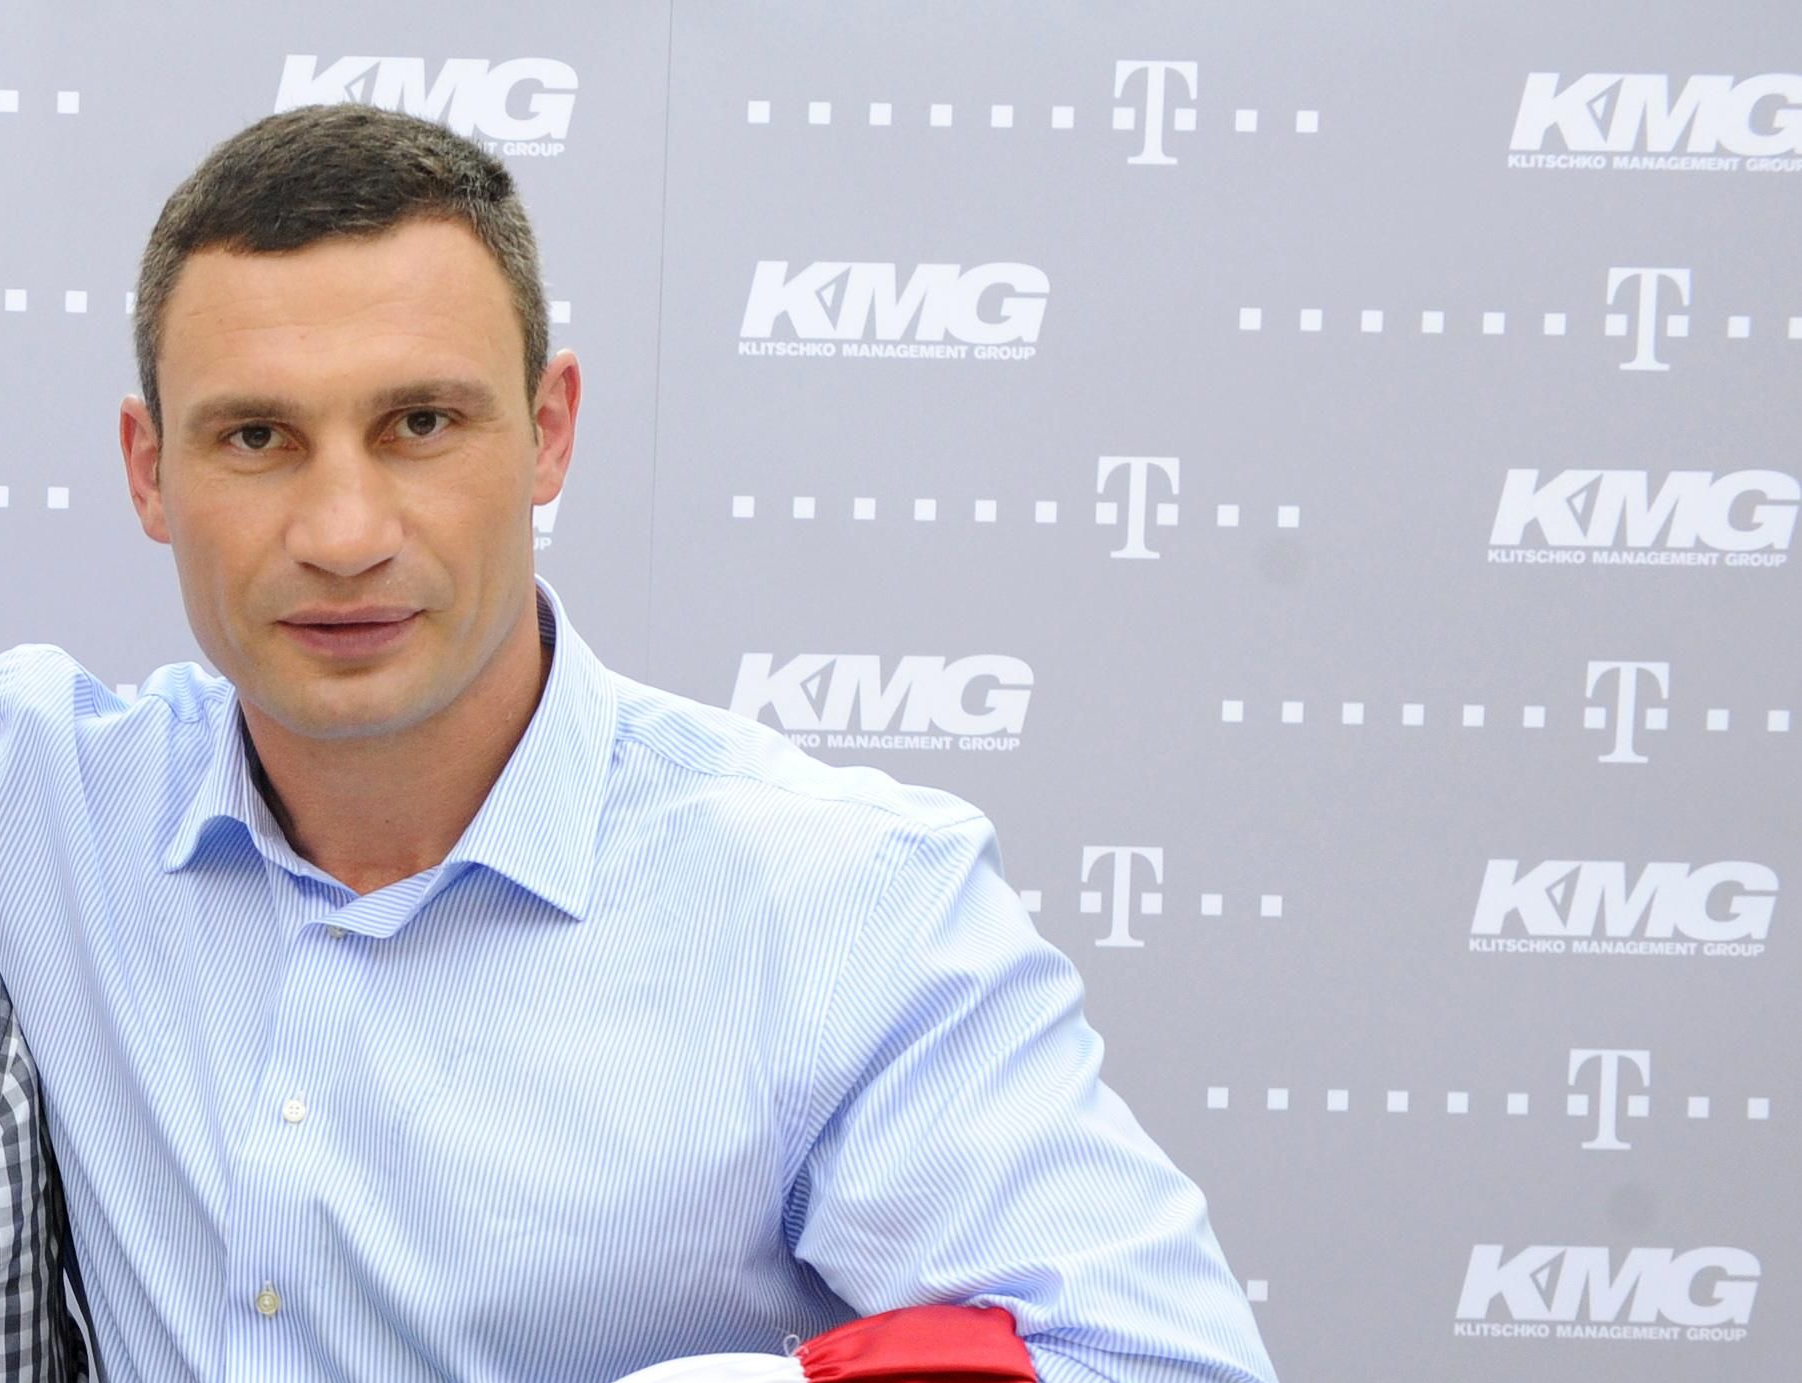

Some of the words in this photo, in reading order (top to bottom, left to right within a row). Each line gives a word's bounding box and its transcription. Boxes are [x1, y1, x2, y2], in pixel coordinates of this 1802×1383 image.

[502, 142, 565, 157] GROUP
[1115, 61, 1197, 164] T
[1510, 72, 1802, 156] KMG
[1507, 154, 1607, 169] KLITSCHKO
[1612, 155, 1741, 171] MANAGEMENT
[740, 261, 1050, 344] KMG
[1607, 268, 1689, 370] T
[738, 341, 837, 357] KLITSCHKO
[842, 343, 969, 359] MANAGEMENT
[973, 345, 1037, 361] GROUP
[1098, 457, 1179, 558] T
[1490, 469, 1800, 551] KMG
[1487, 549, 1586, 564] KLITSCHKO
[1592, 551, 1719, 566] MANAGEMENT
[1725, 552, 1787, 567] GROUP
[729, 653, 1034, 735] KMG
[1586, 662, 1668, 762] T
[827, 734, 952, 750] MANAGEMENT
[958, 736, 1020, 751] GROUP
[1082, 847, 1162, 946] T
[1471, 860, 1778, 940] KMG
[1469, 938, 1566, 953] KLITSCHKO
[1572, 940, 1697, 955] MANAGEMENT
[1703, 942, 1765, 957] GROUP
[1569, 1050, 1649, 1149] T
[1456, 1244, 1760, 1325] KMG
[1453, 1323, 1550, 1338] KLITSCHKO
[1556, 1325, 1681, 1340] MANAGEMENT
[1686, 1327, 1747, 1341] GROUP
